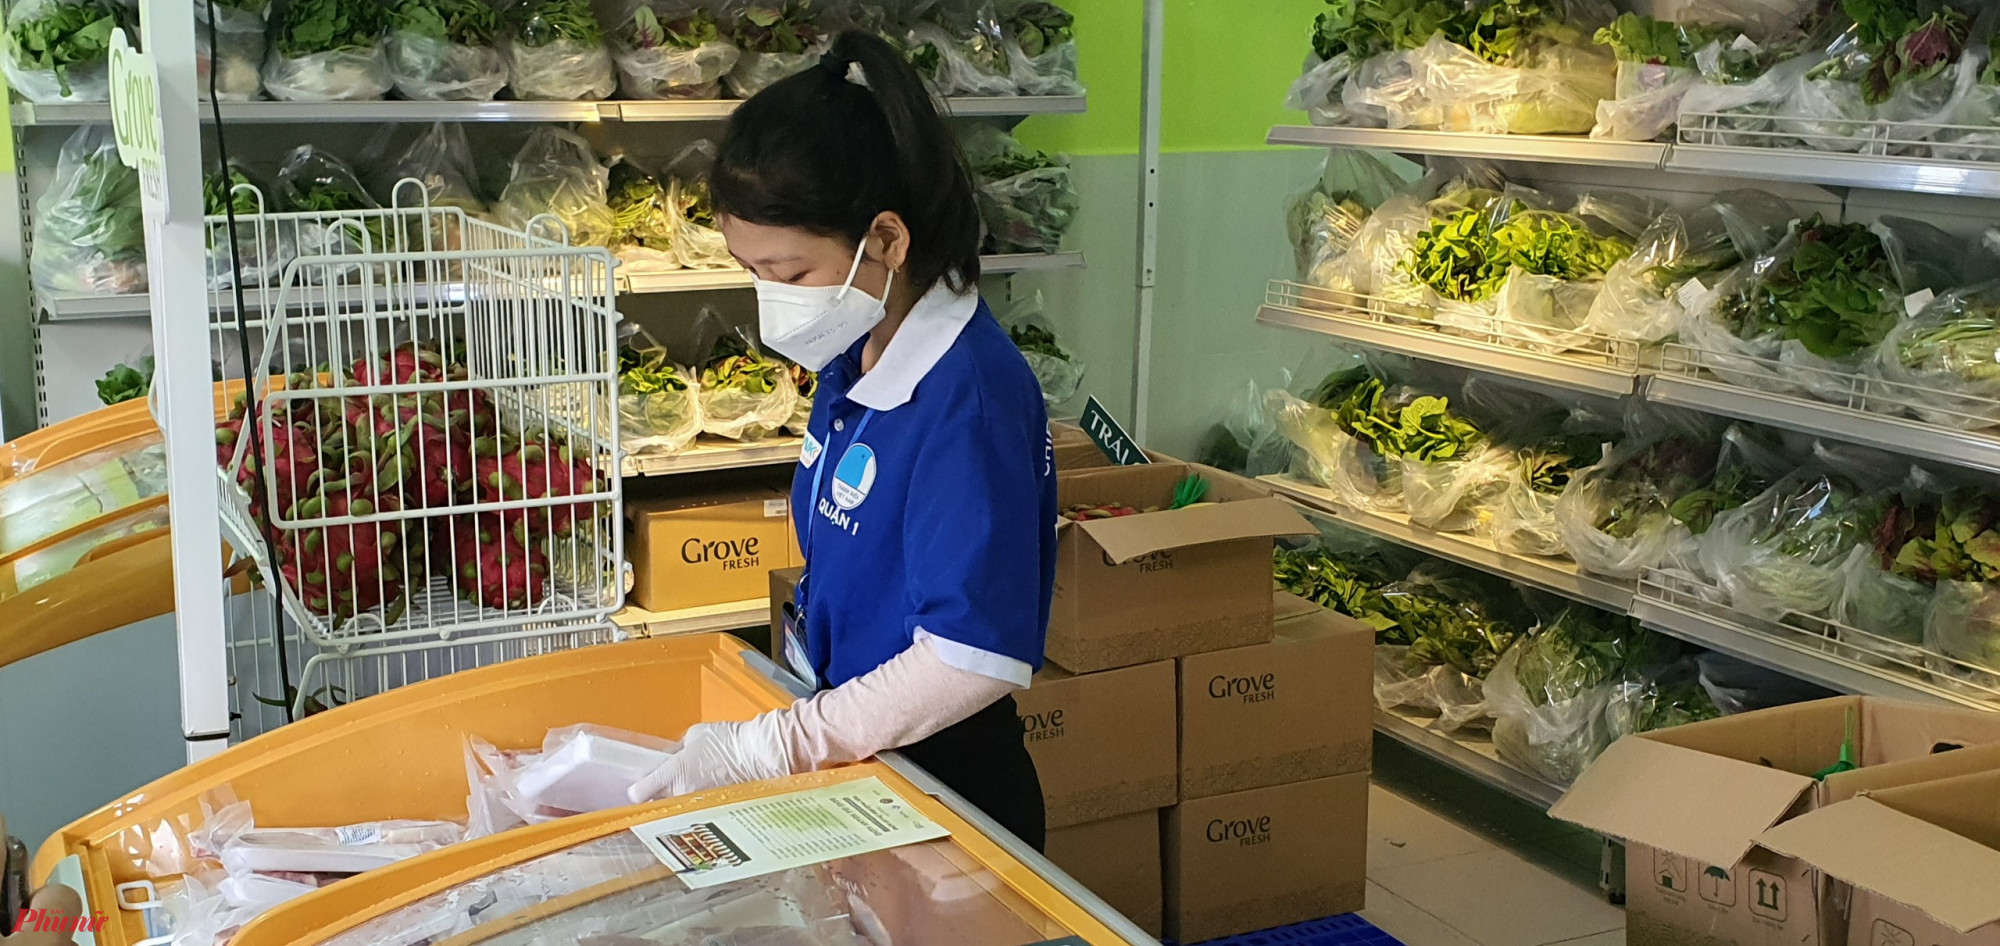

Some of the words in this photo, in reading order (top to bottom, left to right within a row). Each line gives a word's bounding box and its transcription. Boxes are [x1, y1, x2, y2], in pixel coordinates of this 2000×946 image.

[112, 49, 158, 152] Grove
[818, 497, 851, 531] QUẬN
[852, 521, 860, 537] 1
[681, 537, 760, 564] Grove
[723, 556, 760, 571] FRESH
[1140, 559, 1173, 573] FRESH
[1208, 672, 1275, 699] Grove
[1243, 690, 1275, 704] FRESH
[1020, 709, 1065, 732] ove
[1029, 727, 1065, 742] FRESH
[1206, 815, 1272, 843] Grove
[1240, 833, 1271, 847] FRESH
